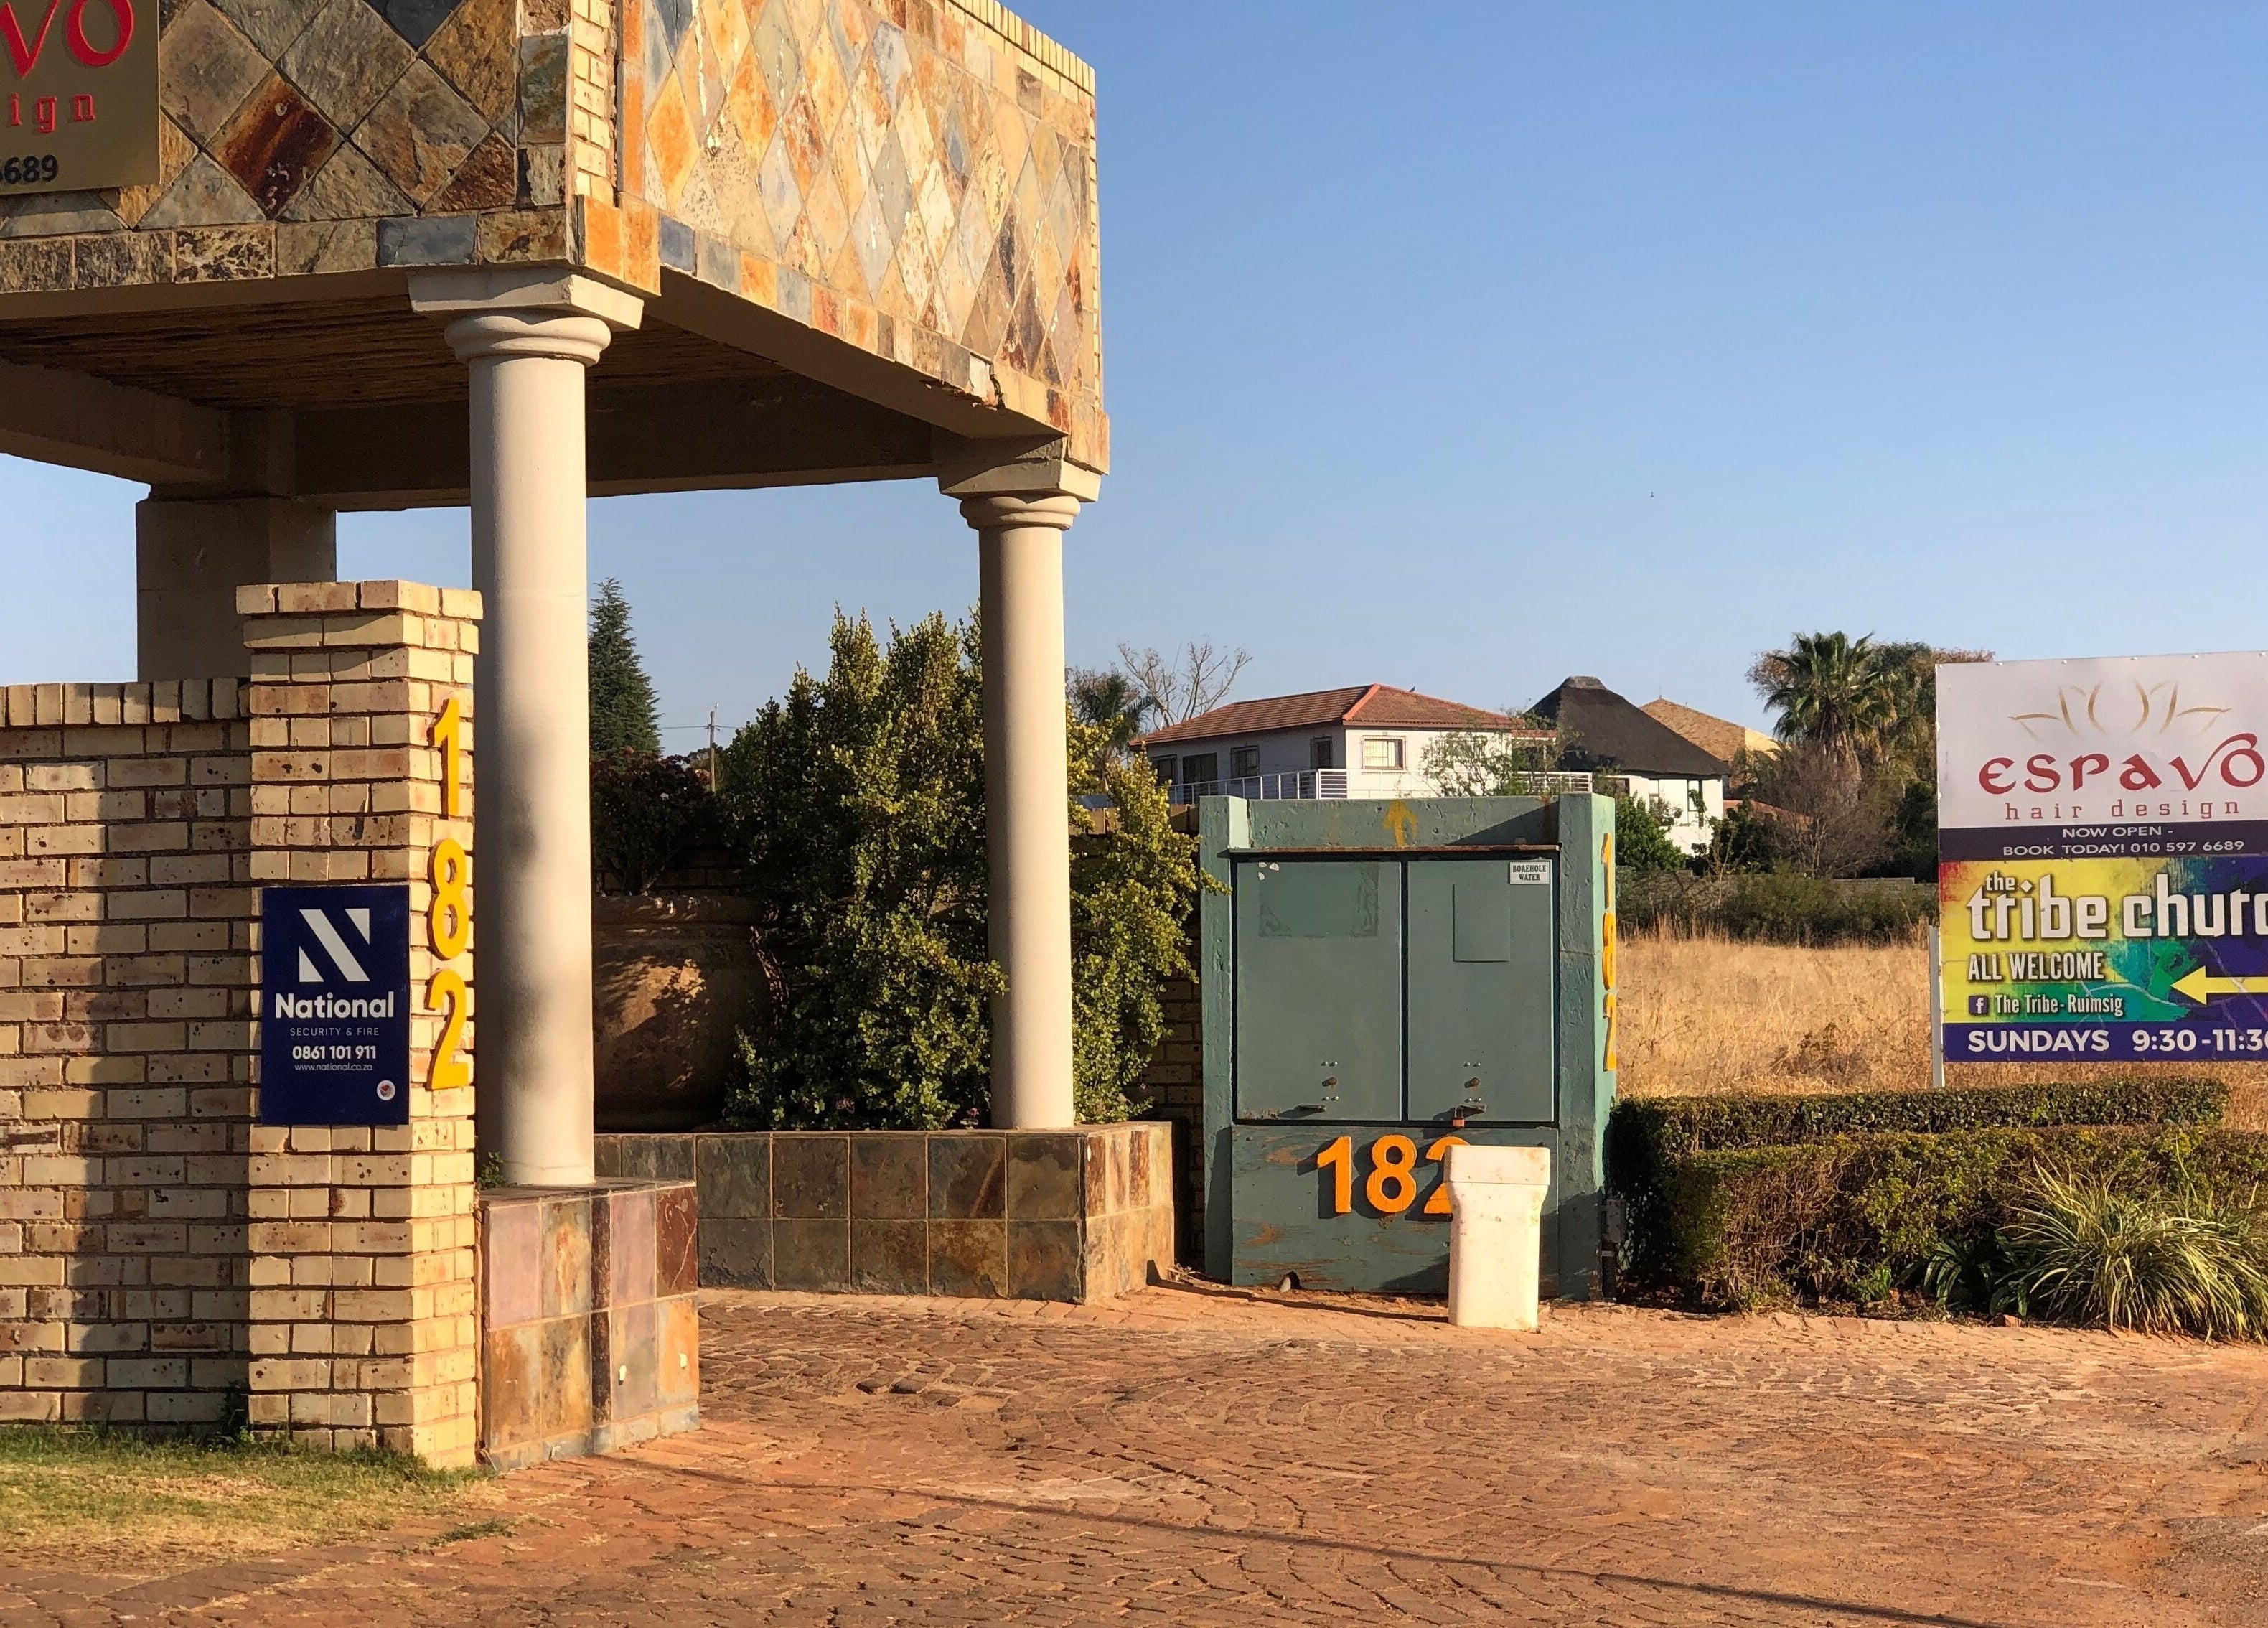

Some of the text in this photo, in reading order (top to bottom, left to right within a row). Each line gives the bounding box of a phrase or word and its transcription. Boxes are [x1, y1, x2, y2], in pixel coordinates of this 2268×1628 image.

[0, 154, 58, 184] 689
[2005, 799, 2239, 820] hair design
[2062, 828, 2107, 838] NOW
[2112, 826, 2162, 837] OPEN
[2003, 841, 2244, 856] BOOK TODAY! 010 597 6689
[1986, 871, 2015, 891] the
[425, 698, 469, 1090] 182
[1967, 874, 2107, 939] tribe
[1968, 952, 2104, 981] ALL WELCOME
[275, 991, 394, 1019] National
[1995, 994, 2020, 1014] The
[289, 1027, 380, 1036] SECURITY & FIRE
[1968, 1030, 2110, 1052] SUNDAYS
[292, 1045, 376, 1059] 0861 101 911
[294, 1062, 372, 1071] www.national.co.za
